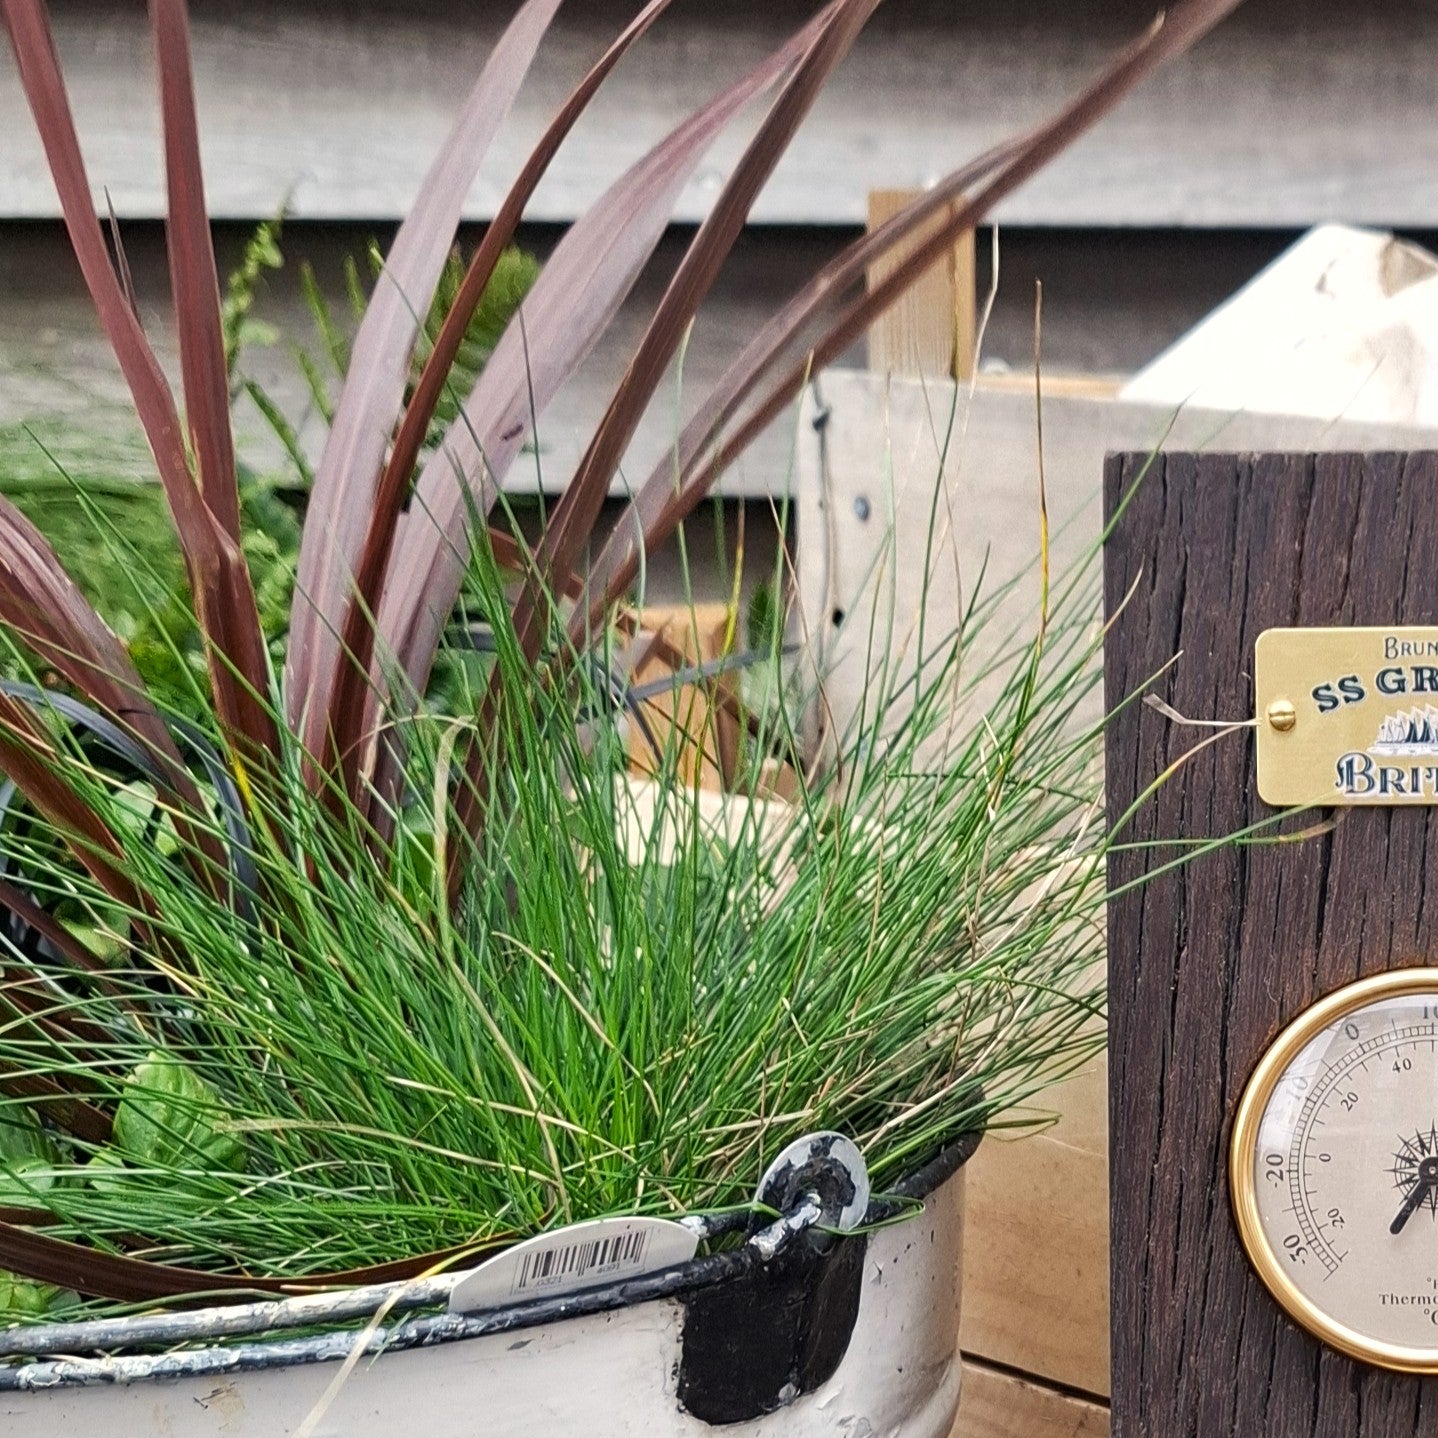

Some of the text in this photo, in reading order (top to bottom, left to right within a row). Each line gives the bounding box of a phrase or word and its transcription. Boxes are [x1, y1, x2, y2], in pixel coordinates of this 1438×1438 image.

[1312, 675, 1365, 713] SS
[1345, 1023, 1360, 1040] 0
[1392, 1058, 1411, 1073] 40
[1341, 1092, 1359, 1112] 20
[1319, 1154, 1331, 1162] 0
[1265, 1154, 1283, 1189] -20
[1283, 1234, 1308, 1265] -30
